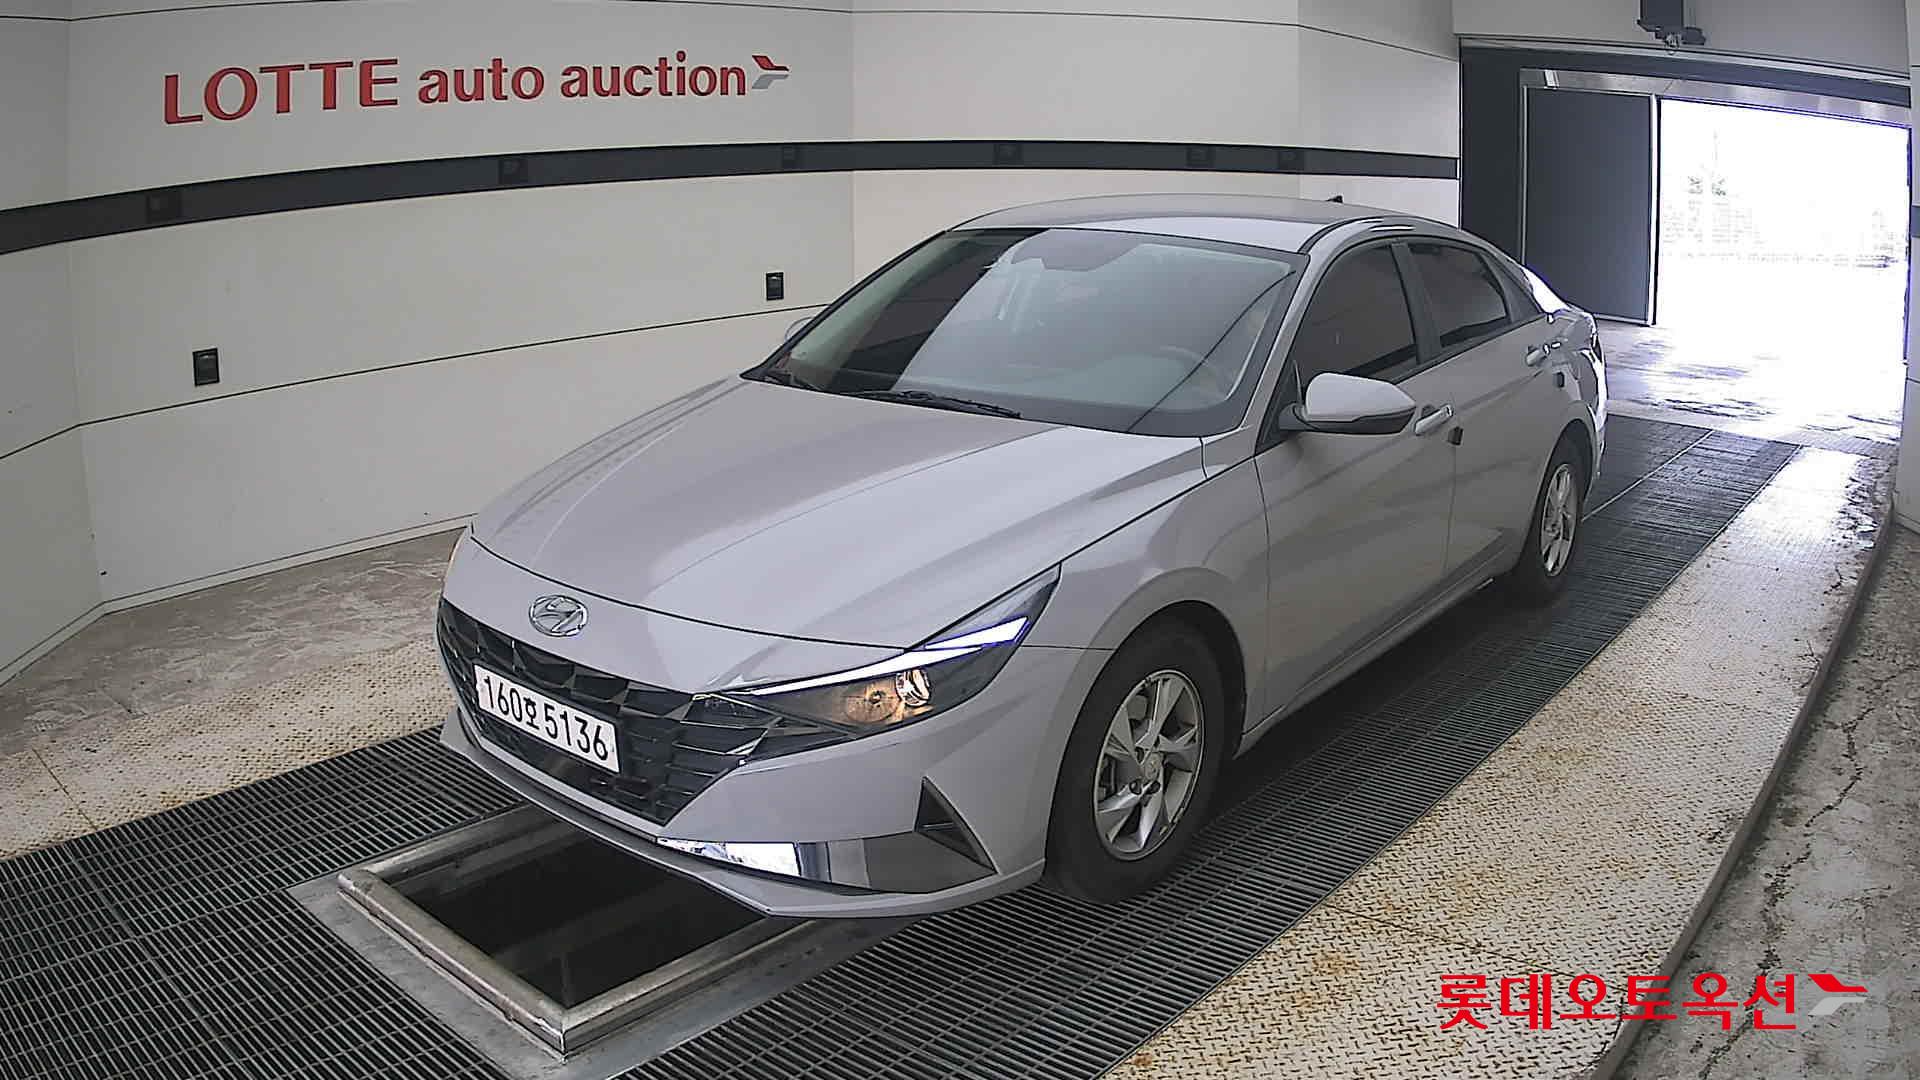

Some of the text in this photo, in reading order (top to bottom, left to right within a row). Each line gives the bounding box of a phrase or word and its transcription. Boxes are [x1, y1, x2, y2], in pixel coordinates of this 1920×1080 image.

[164, 51, 747, 124] LOTTE auto auction
